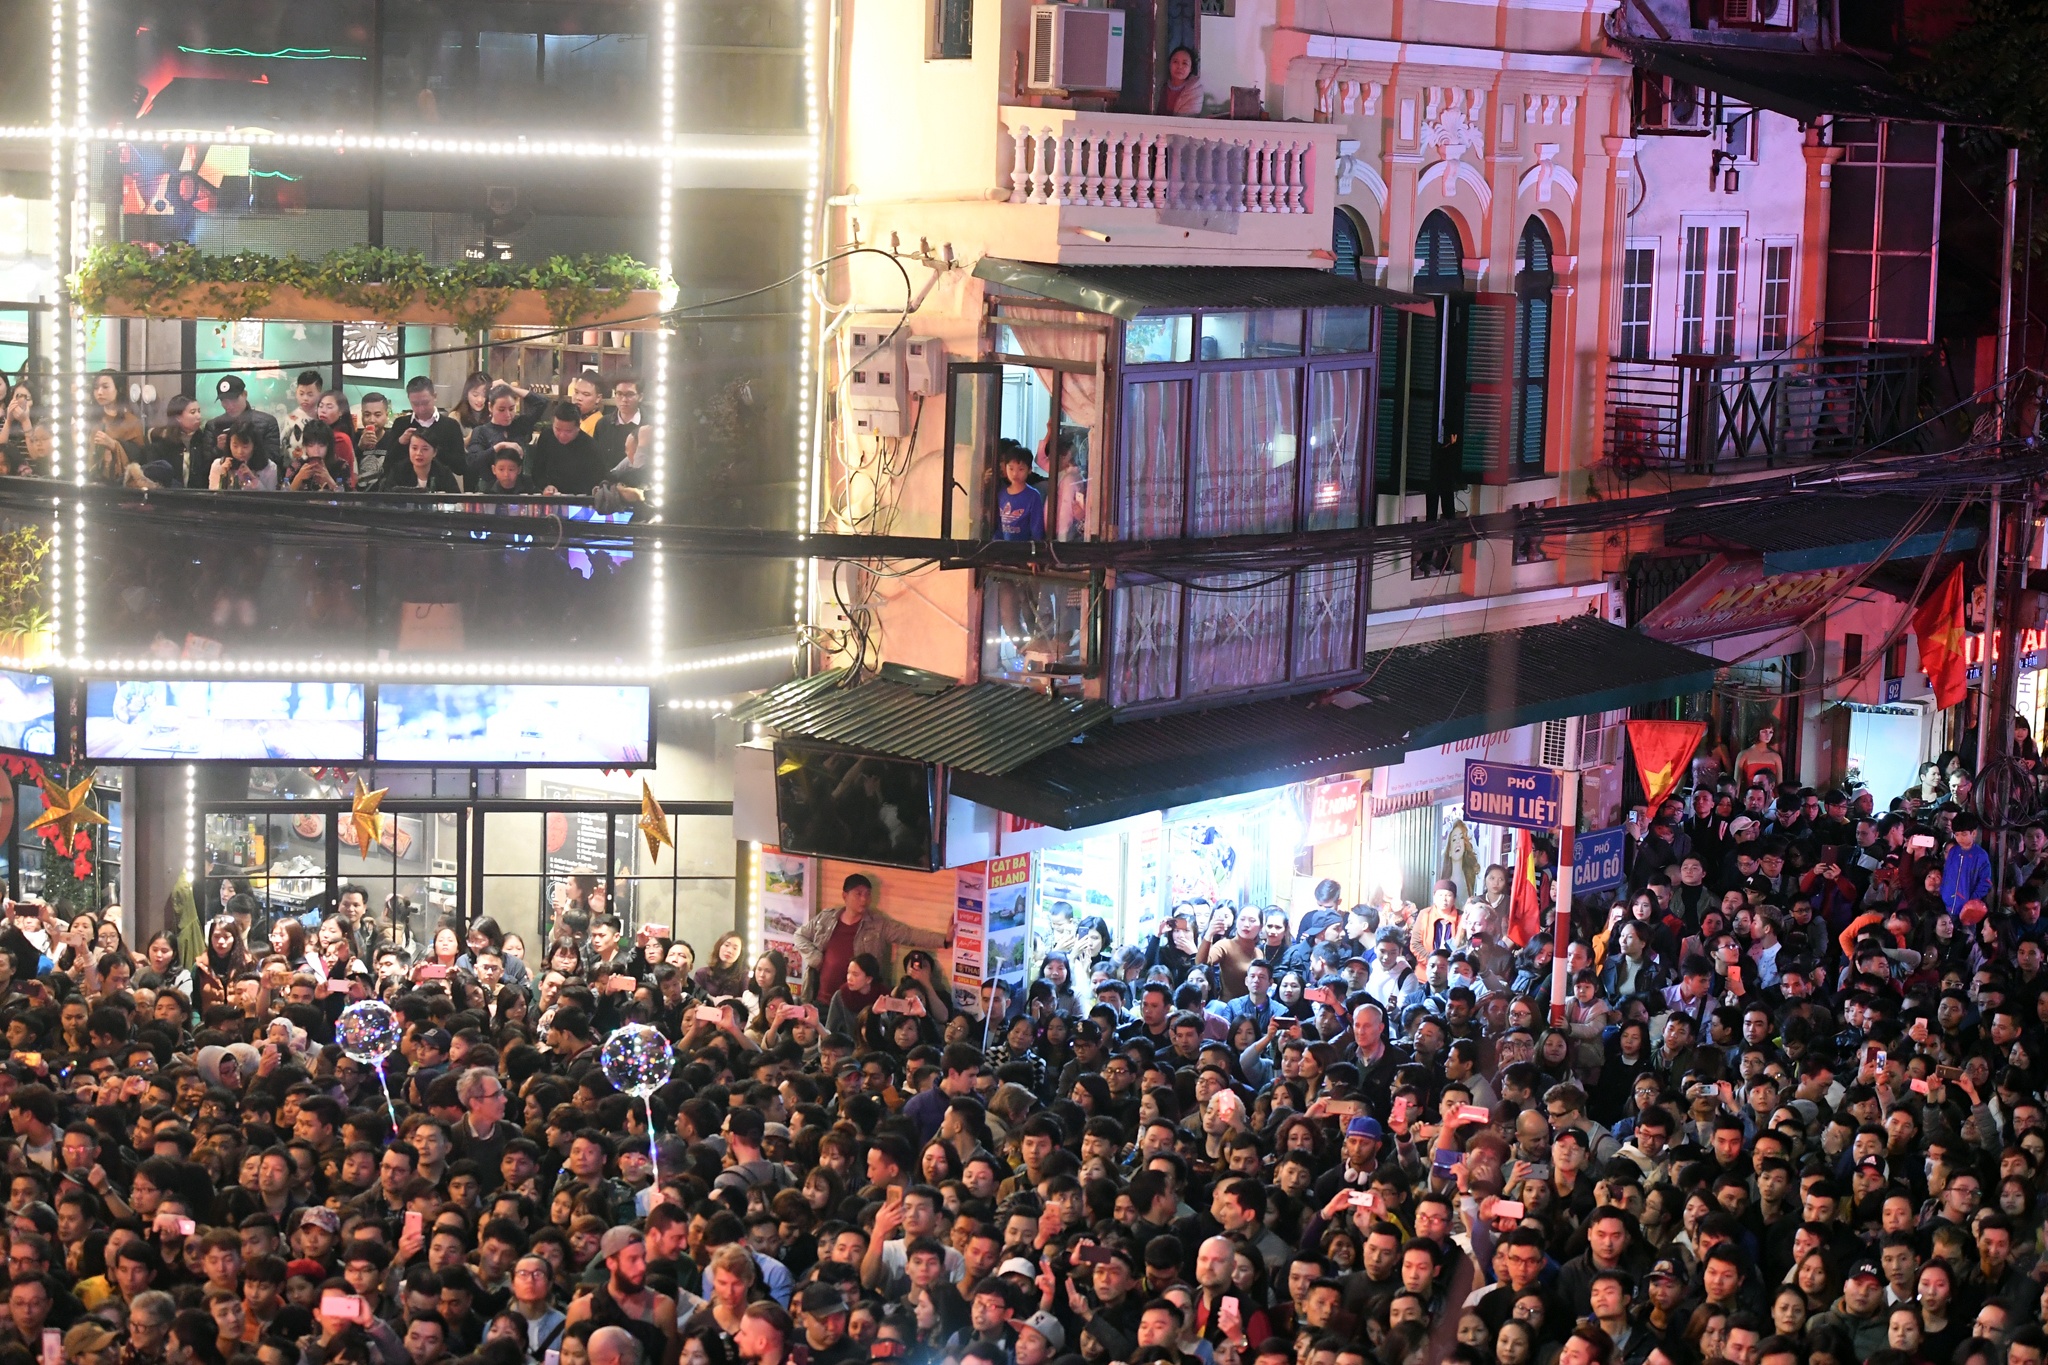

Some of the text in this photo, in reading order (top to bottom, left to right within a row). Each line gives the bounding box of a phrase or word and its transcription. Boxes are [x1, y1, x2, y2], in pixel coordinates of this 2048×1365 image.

[1888, 684, 1900, 700] 92
[1507, 776, 1536, 790] PHỐ
[1470, 791, 1557, 824] ĐINH LIỆT
[1594, 839, 1610, 854] PHỐ
[992, 860, 1010, 872] CAT
[1012, 856, 1026, 868] BA
[1574, 848, 1620, 886] CẦU GỖ
[991, 871, 1026, 888] ISLAND
